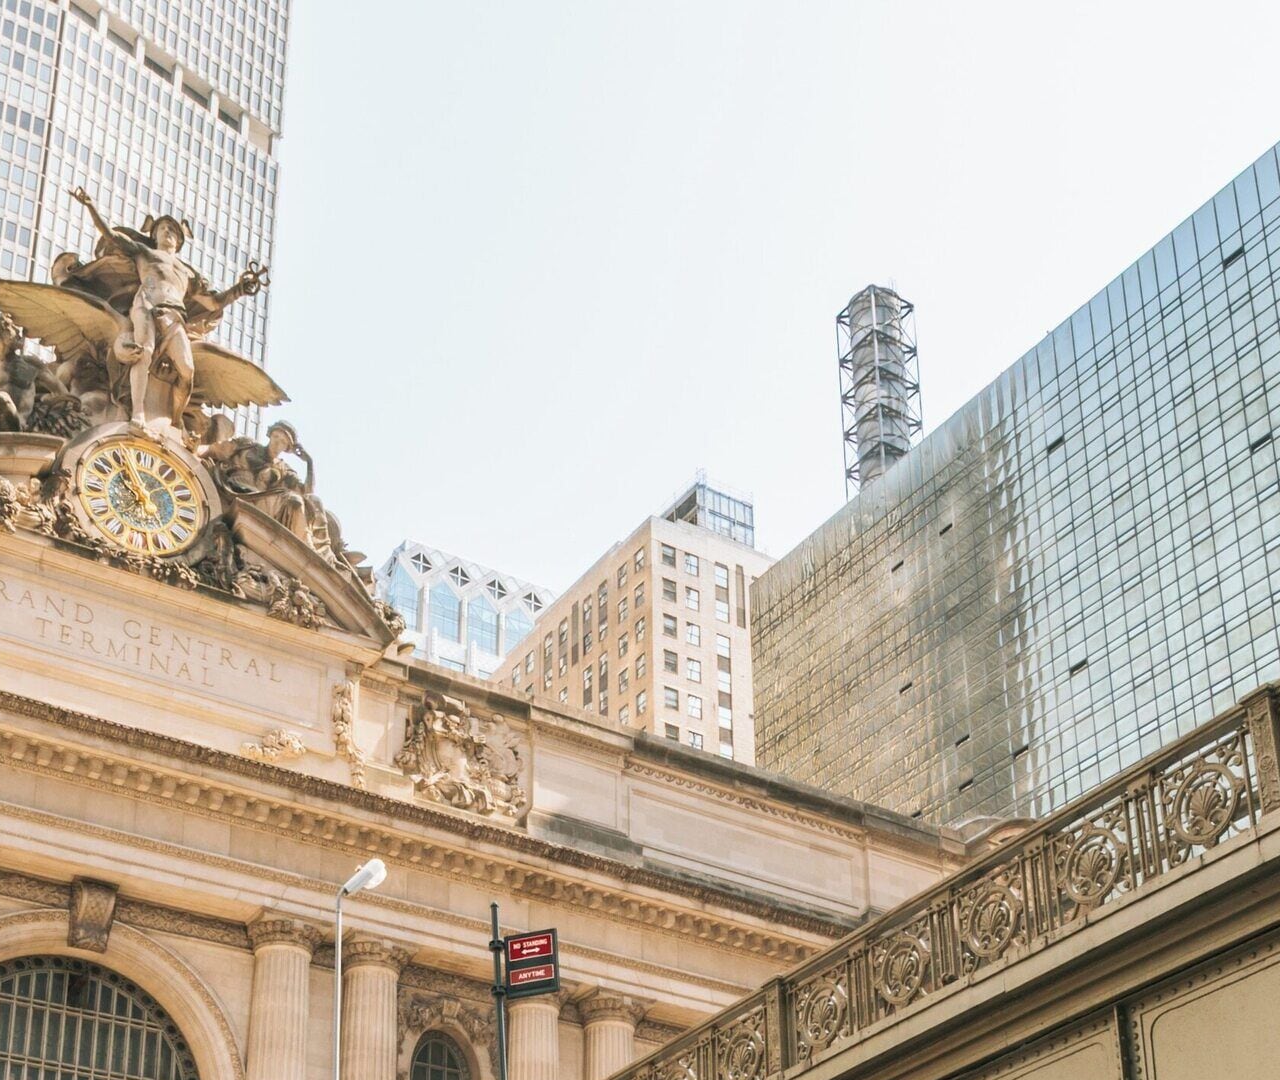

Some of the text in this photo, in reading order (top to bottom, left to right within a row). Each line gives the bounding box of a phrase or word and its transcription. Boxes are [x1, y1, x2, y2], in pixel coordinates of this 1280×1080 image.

[34, 616, 216, 687] TERMINAL
[122, 618, 283, 683] CENTRAL
[523, 938, 548, 948] STANDING
[518, 969, 546, 980] ANYTIME
